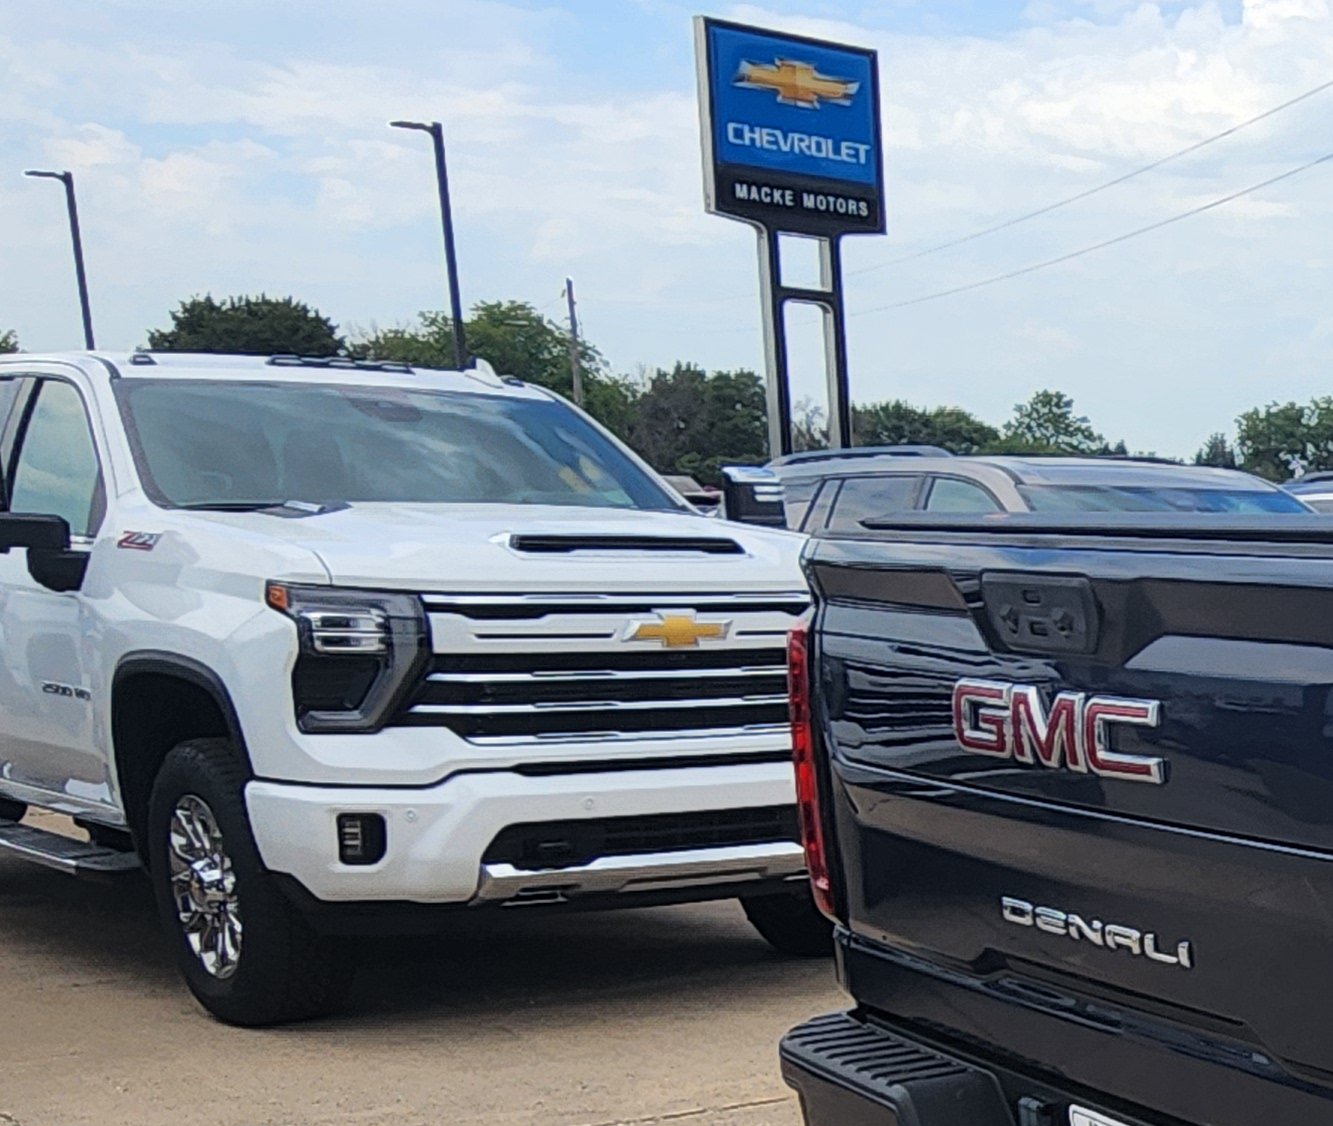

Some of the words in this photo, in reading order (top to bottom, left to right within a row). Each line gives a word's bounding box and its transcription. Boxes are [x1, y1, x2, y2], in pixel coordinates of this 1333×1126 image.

[727, 122, 871, 165] CHEVROLET
[734, 183, 794, 205] MACKE
[803, 193, 869, 216] MOTORS
[952, 677, 1167, 785] GMC
[1001, 896, 1193, 969] DENALI
